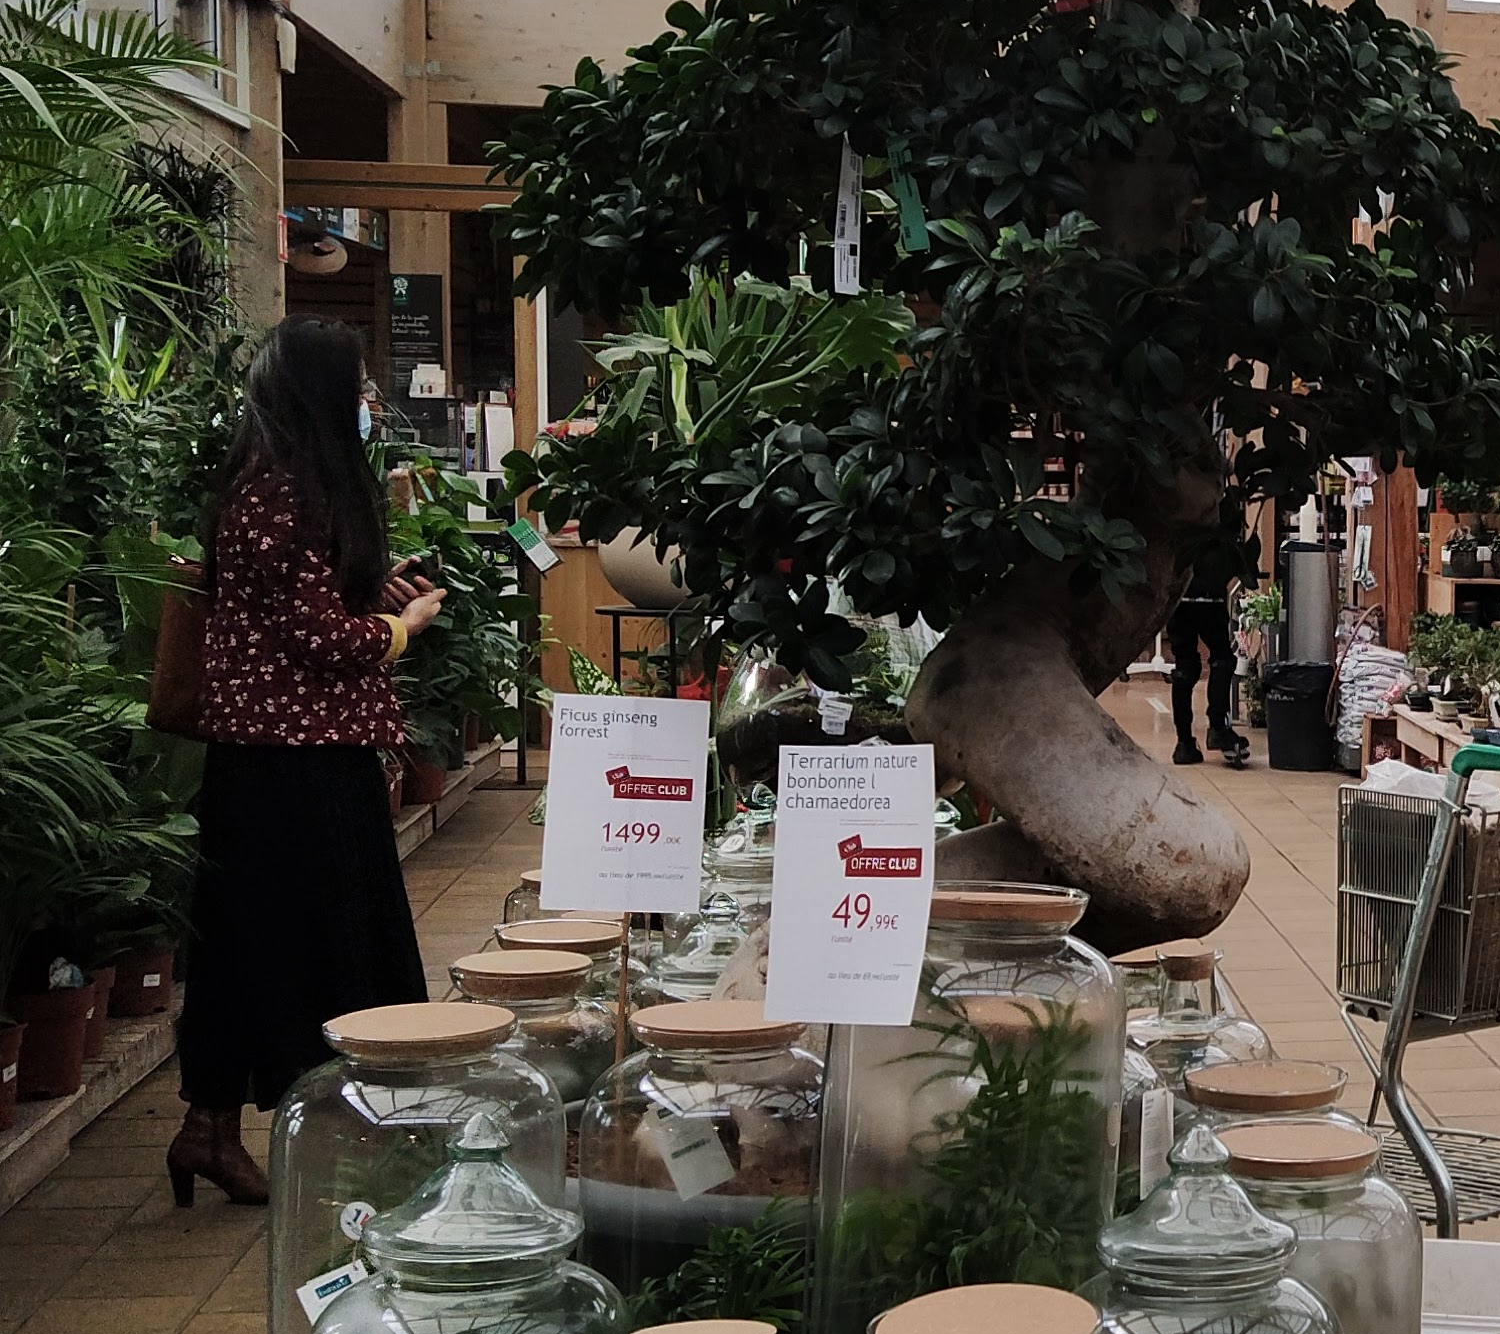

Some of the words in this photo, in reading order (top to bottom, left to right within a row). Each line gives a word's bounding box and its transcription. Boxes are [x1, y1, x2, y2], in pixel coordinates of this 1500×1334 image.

[559, 707, 597, 723] Ficus
[603, 709, 658, 727] ginseng
[559, 723, 609, 740] forrest
[788, 753, 869, 770] Terrarium
[873, 754, 918, 770] nature
[619, 783, 657, 795] OFFRE
[657, 784, 688, 796] CLUB
[786, 772, 866, 790] bonbonne
[785, 793, 891, 811] chamaedorea
[850, 857, 886, 870] OFFRE
[888, 857, 917, 870] CLUB
